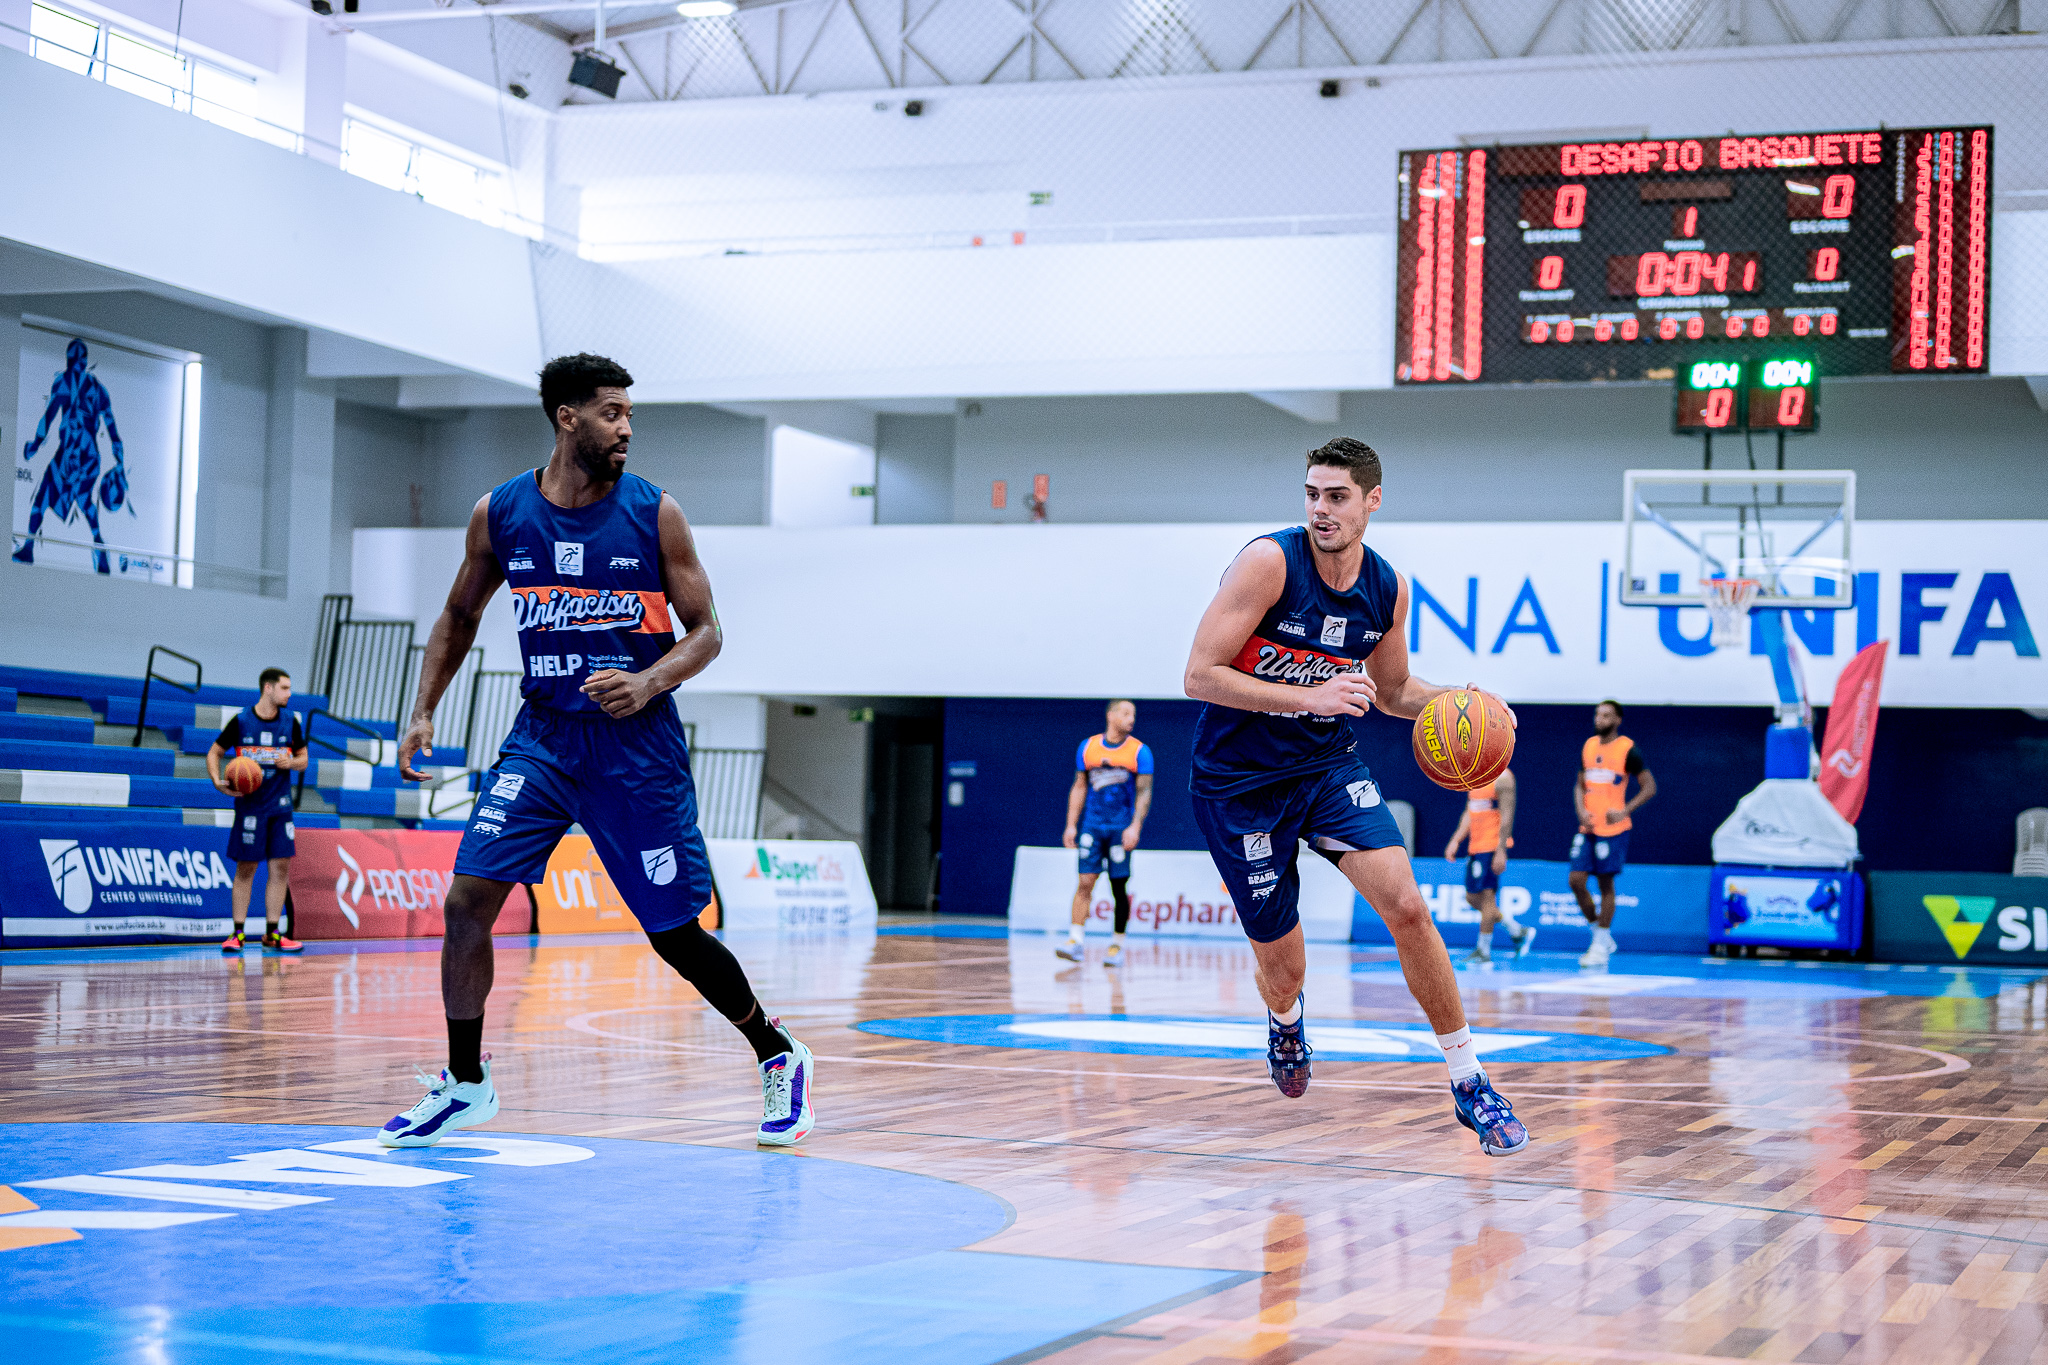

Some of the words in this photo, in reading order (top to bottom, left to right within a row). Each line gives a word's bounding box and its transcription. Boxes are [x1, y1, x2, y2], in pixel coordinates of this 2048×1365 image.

[1561, 140, 1703, 175] DESAFIO
[1719, 133, 1882, 169] BASQUETE
[1553, 184, 1587, 228] 0
[1822, 174, 1856, 218] 0
[1683, 206, 1698, 237] 1
[1538, 256, 1564, 290] 0
[1815, 247, 1839, 281] 0
[1705, 388, 1733, 427] 0
[1277, 622, 1306, 637] BRASIL
[530, 654, 582, 677] HELP
[86, 846, 233, 890] UNIFACISA
[100, 891, 136, 904] CENTRO
[1420, 884, 1532, 923] HEP
